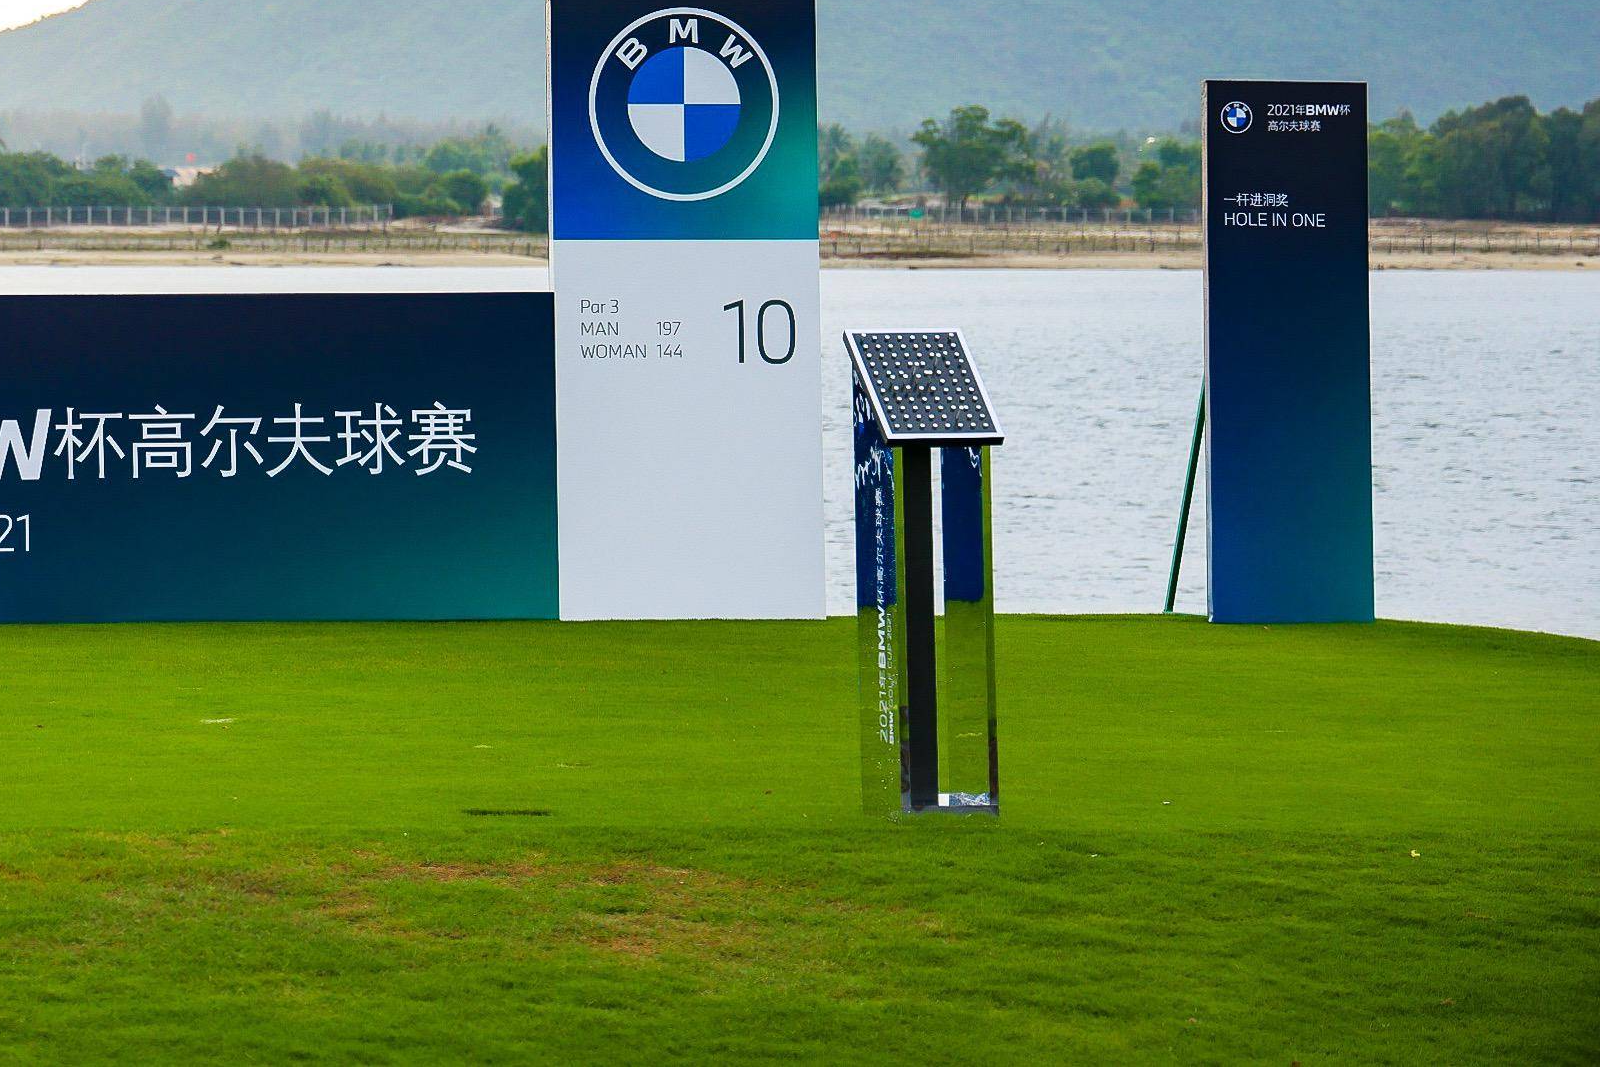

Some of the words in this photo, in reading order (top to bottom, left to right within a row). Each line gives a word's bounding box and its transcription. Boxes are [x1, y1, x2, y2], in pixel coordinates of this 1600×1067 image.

[615, 18, 754, 71] BMW
[1267, 104, 1351, 116] 2021年BMW杯
[1267, 120, 1321, 132] 高尔夫球赛
[1223, 193, 1289, 207] 一杆进洞奖
[1224, 212, 1268, 226] HOLE
[1272, 213, 1287, 227] IN
[1292, 213, 1326, 227] ONE
[580, 299, 606, 314] Par
[610, 299, 619, 314] 3
[580, 321, 619, 336] MAN
[656, 321, 681, 336] 197
[723, 299, 796, 365] 10
[580, 344, 647, 359] WOMAN
[656, 344, 683, 358] 144
